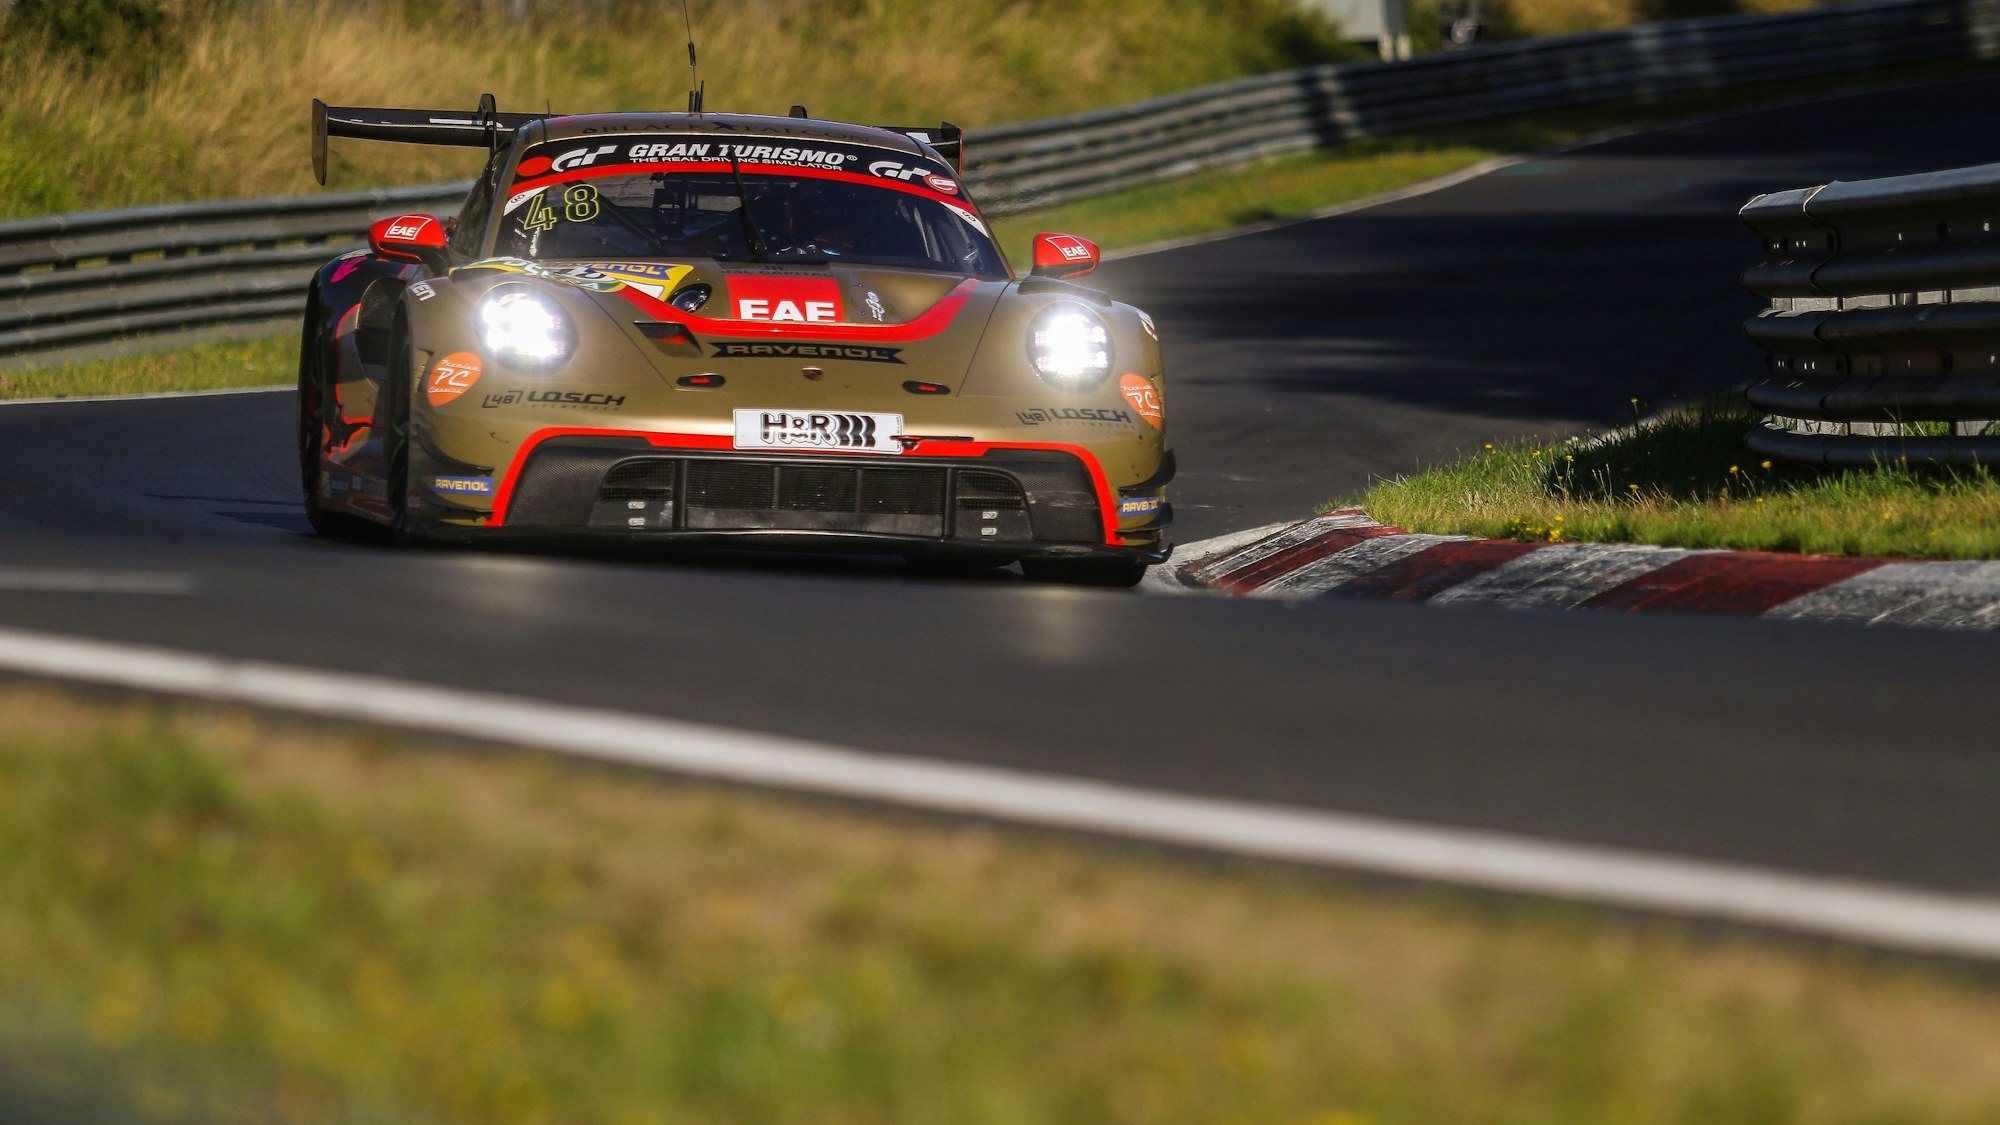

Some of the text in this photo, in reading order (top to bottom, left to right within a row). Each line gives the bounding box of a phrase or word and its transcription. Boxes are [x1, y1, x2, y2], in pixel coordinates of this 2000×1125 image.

[628, 144, 708, 158] GRAN
[701, 156, 756, 164] DRIVNG
[761, 158, 842, 171] SIMULATOR
[524, 185, 600, 231] 48
[390, 225, 417, 238] EAE
[1062, 246, 1087, 257] EAE
[739, 299, 836, 323] EAE
[726, 344, 889, 360] RAVENOL
[434, 367, 470, 387] PC
[527, 391, 626, 406] LOSCH
[1127, 391, 1160, 410] PC
[1050, 408, 1132, 423] LOSCH
[762, 413, 834, 443] H&R
[435, 479, 488, 492] RAVENOL
